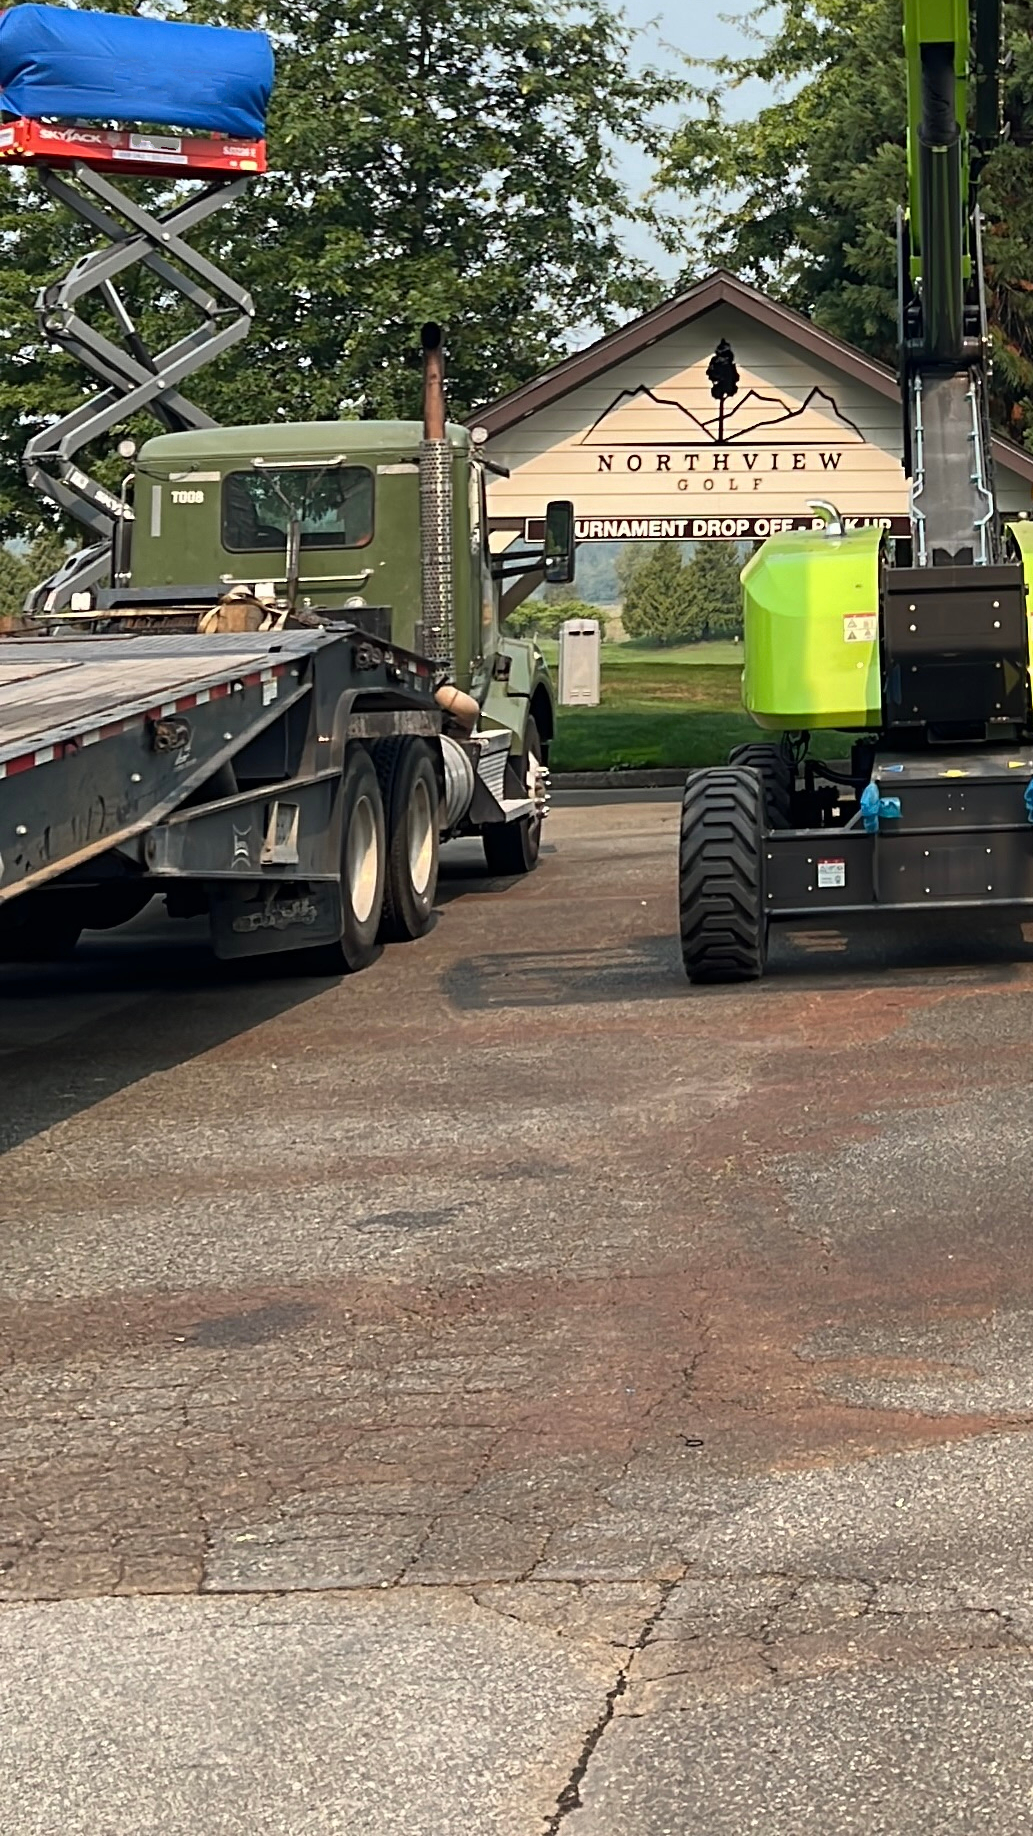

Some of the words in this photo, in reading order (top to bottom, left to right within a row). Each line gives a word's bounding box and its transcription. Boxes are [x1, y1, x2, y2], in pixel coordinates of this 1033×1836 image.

[39, 128, 102, 144] SKYJACK
[597, 452, 843, 472] NORTHVIEW
[677, 478, 763, 491] GOLF
[574, 519, 689, 538] URNAMENT
[692, 519, 750, 537] DROP
[754, 518, 794, 537] OFF
[811, 518, 860, 531] PK
